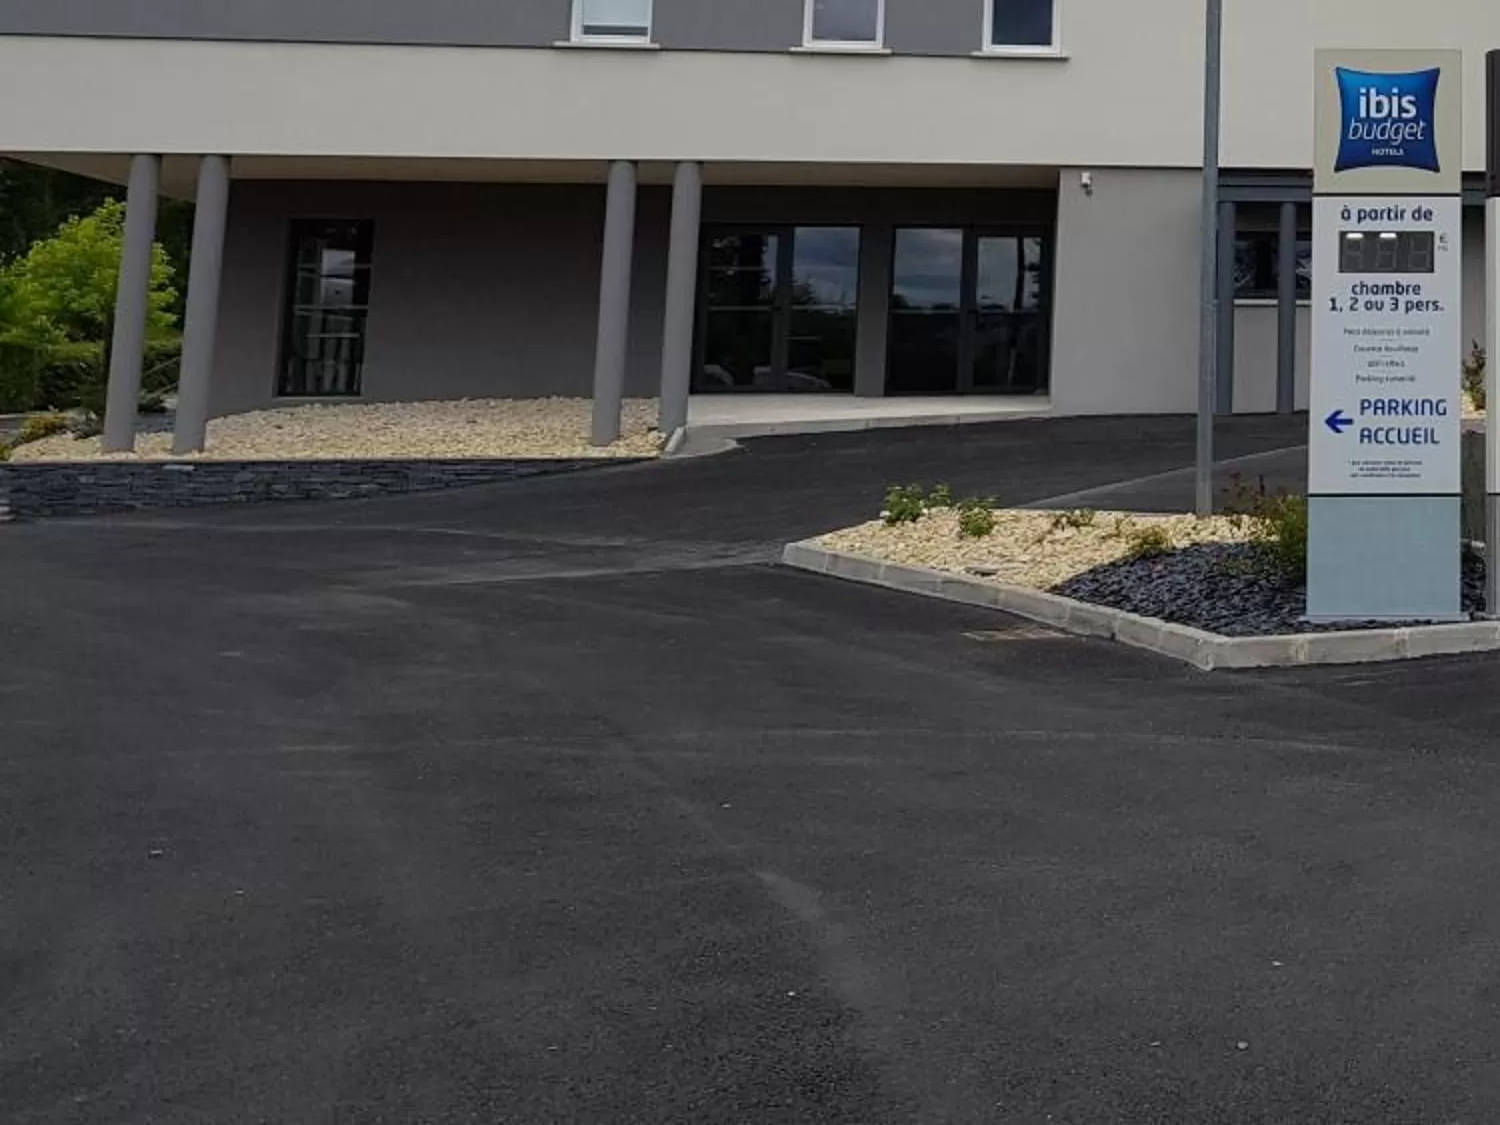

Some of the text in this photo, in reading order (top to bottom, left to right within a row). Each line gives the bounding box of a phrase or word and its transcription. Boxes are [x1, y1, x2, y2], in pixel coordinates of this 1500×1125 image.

[1359, 87, 1417, 118] ibis
[1348, 116, 1427, 146] budget
[1341, 205, 1434, 224] à partir de
[1351, 281, 1421, 296] chambre
[1329, 296, 1445, 314] 1, 2 ou 3 pers.
[1359, 398, 1448, 416] PARKING
[1359, 426, 1441, 445] ACCUEIL
